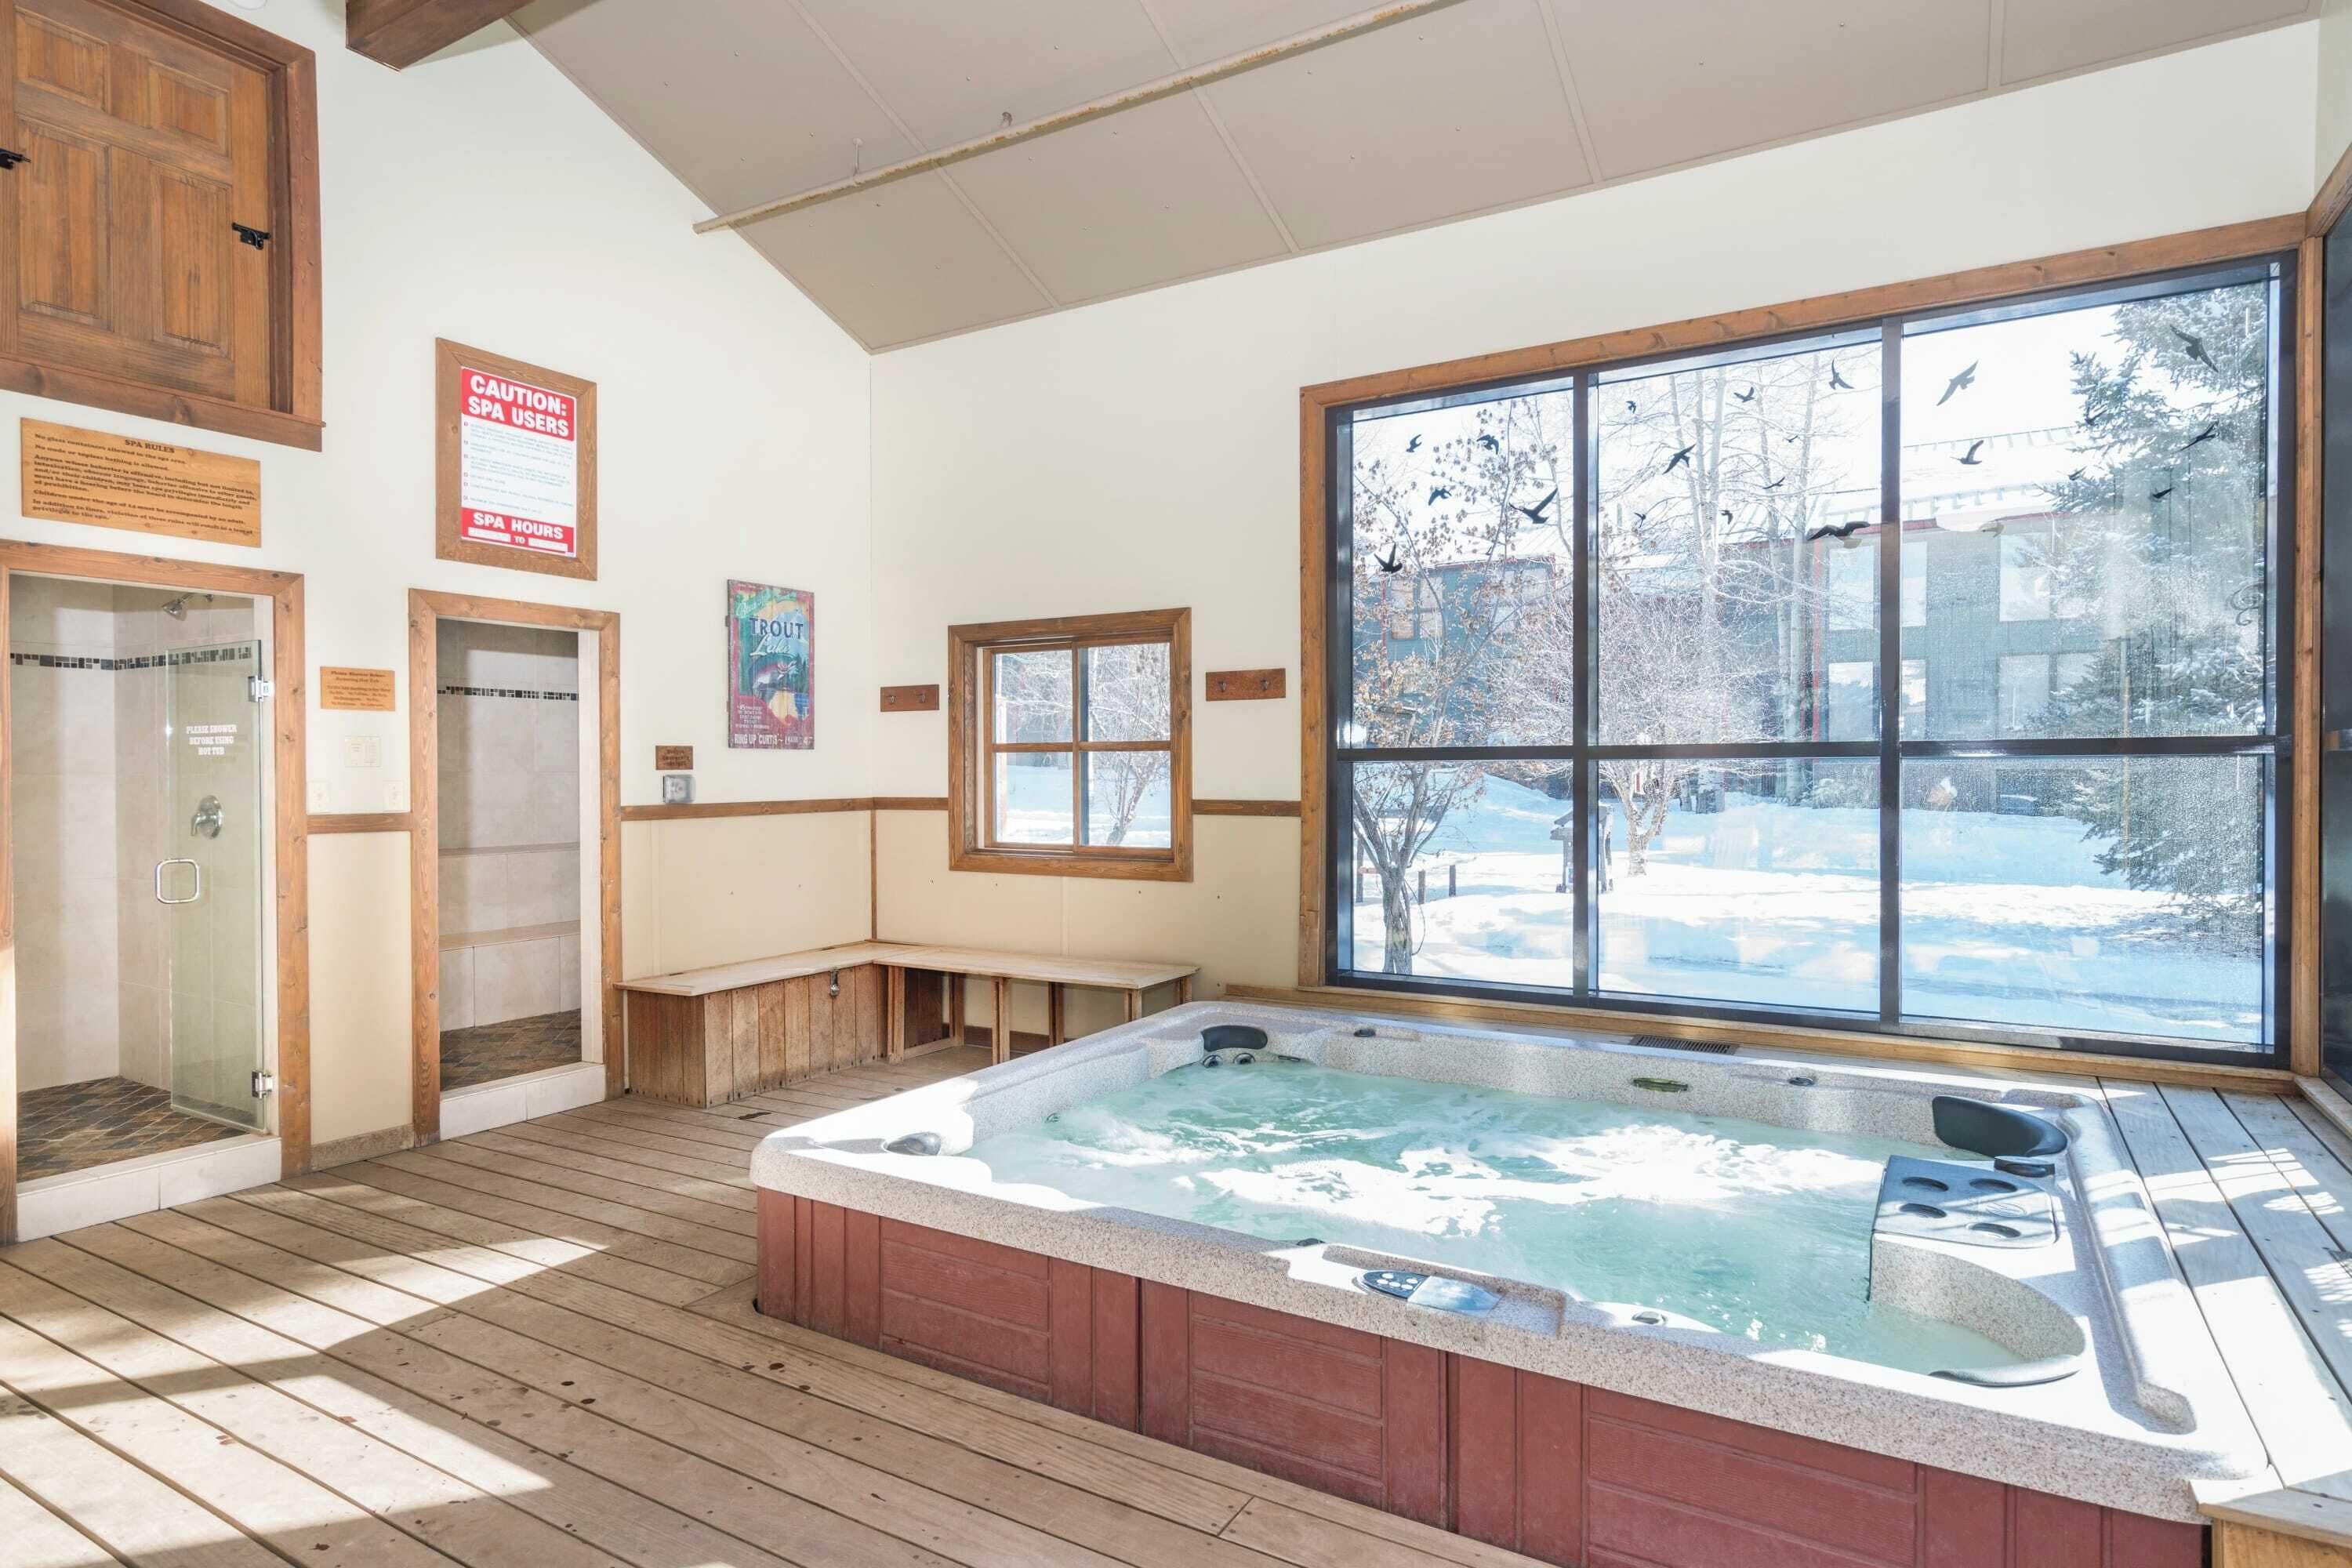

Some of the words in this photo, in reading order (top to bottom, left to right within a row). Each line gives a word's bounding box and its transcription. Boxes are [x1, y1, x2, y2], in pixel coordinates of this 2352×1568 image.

[470, 375, 568, 416] CAUTION:
[468, 397, 505, 421] SPA
[512, 408, 569, 437] USERS
[125, 439, 143, 448] SPA
[145, 443, 175, 454] RULES
[34, 489, 67, 498] Children
[474, 512, 505, 530] SPA
[511, 520, 564, 539] HOURS
[750, 618, 803, 639] TROUT
[750, 633, 791, 657] Lake
[209, 724, 238, 733] SHOWER
[189, 736, 214, 745] BEFORE
[215, 735, 234, 744] USING
[735, 733, 748, 745] RING
[749, 734, 757, 744] UP
[212, 746, 225, 755] TUB
